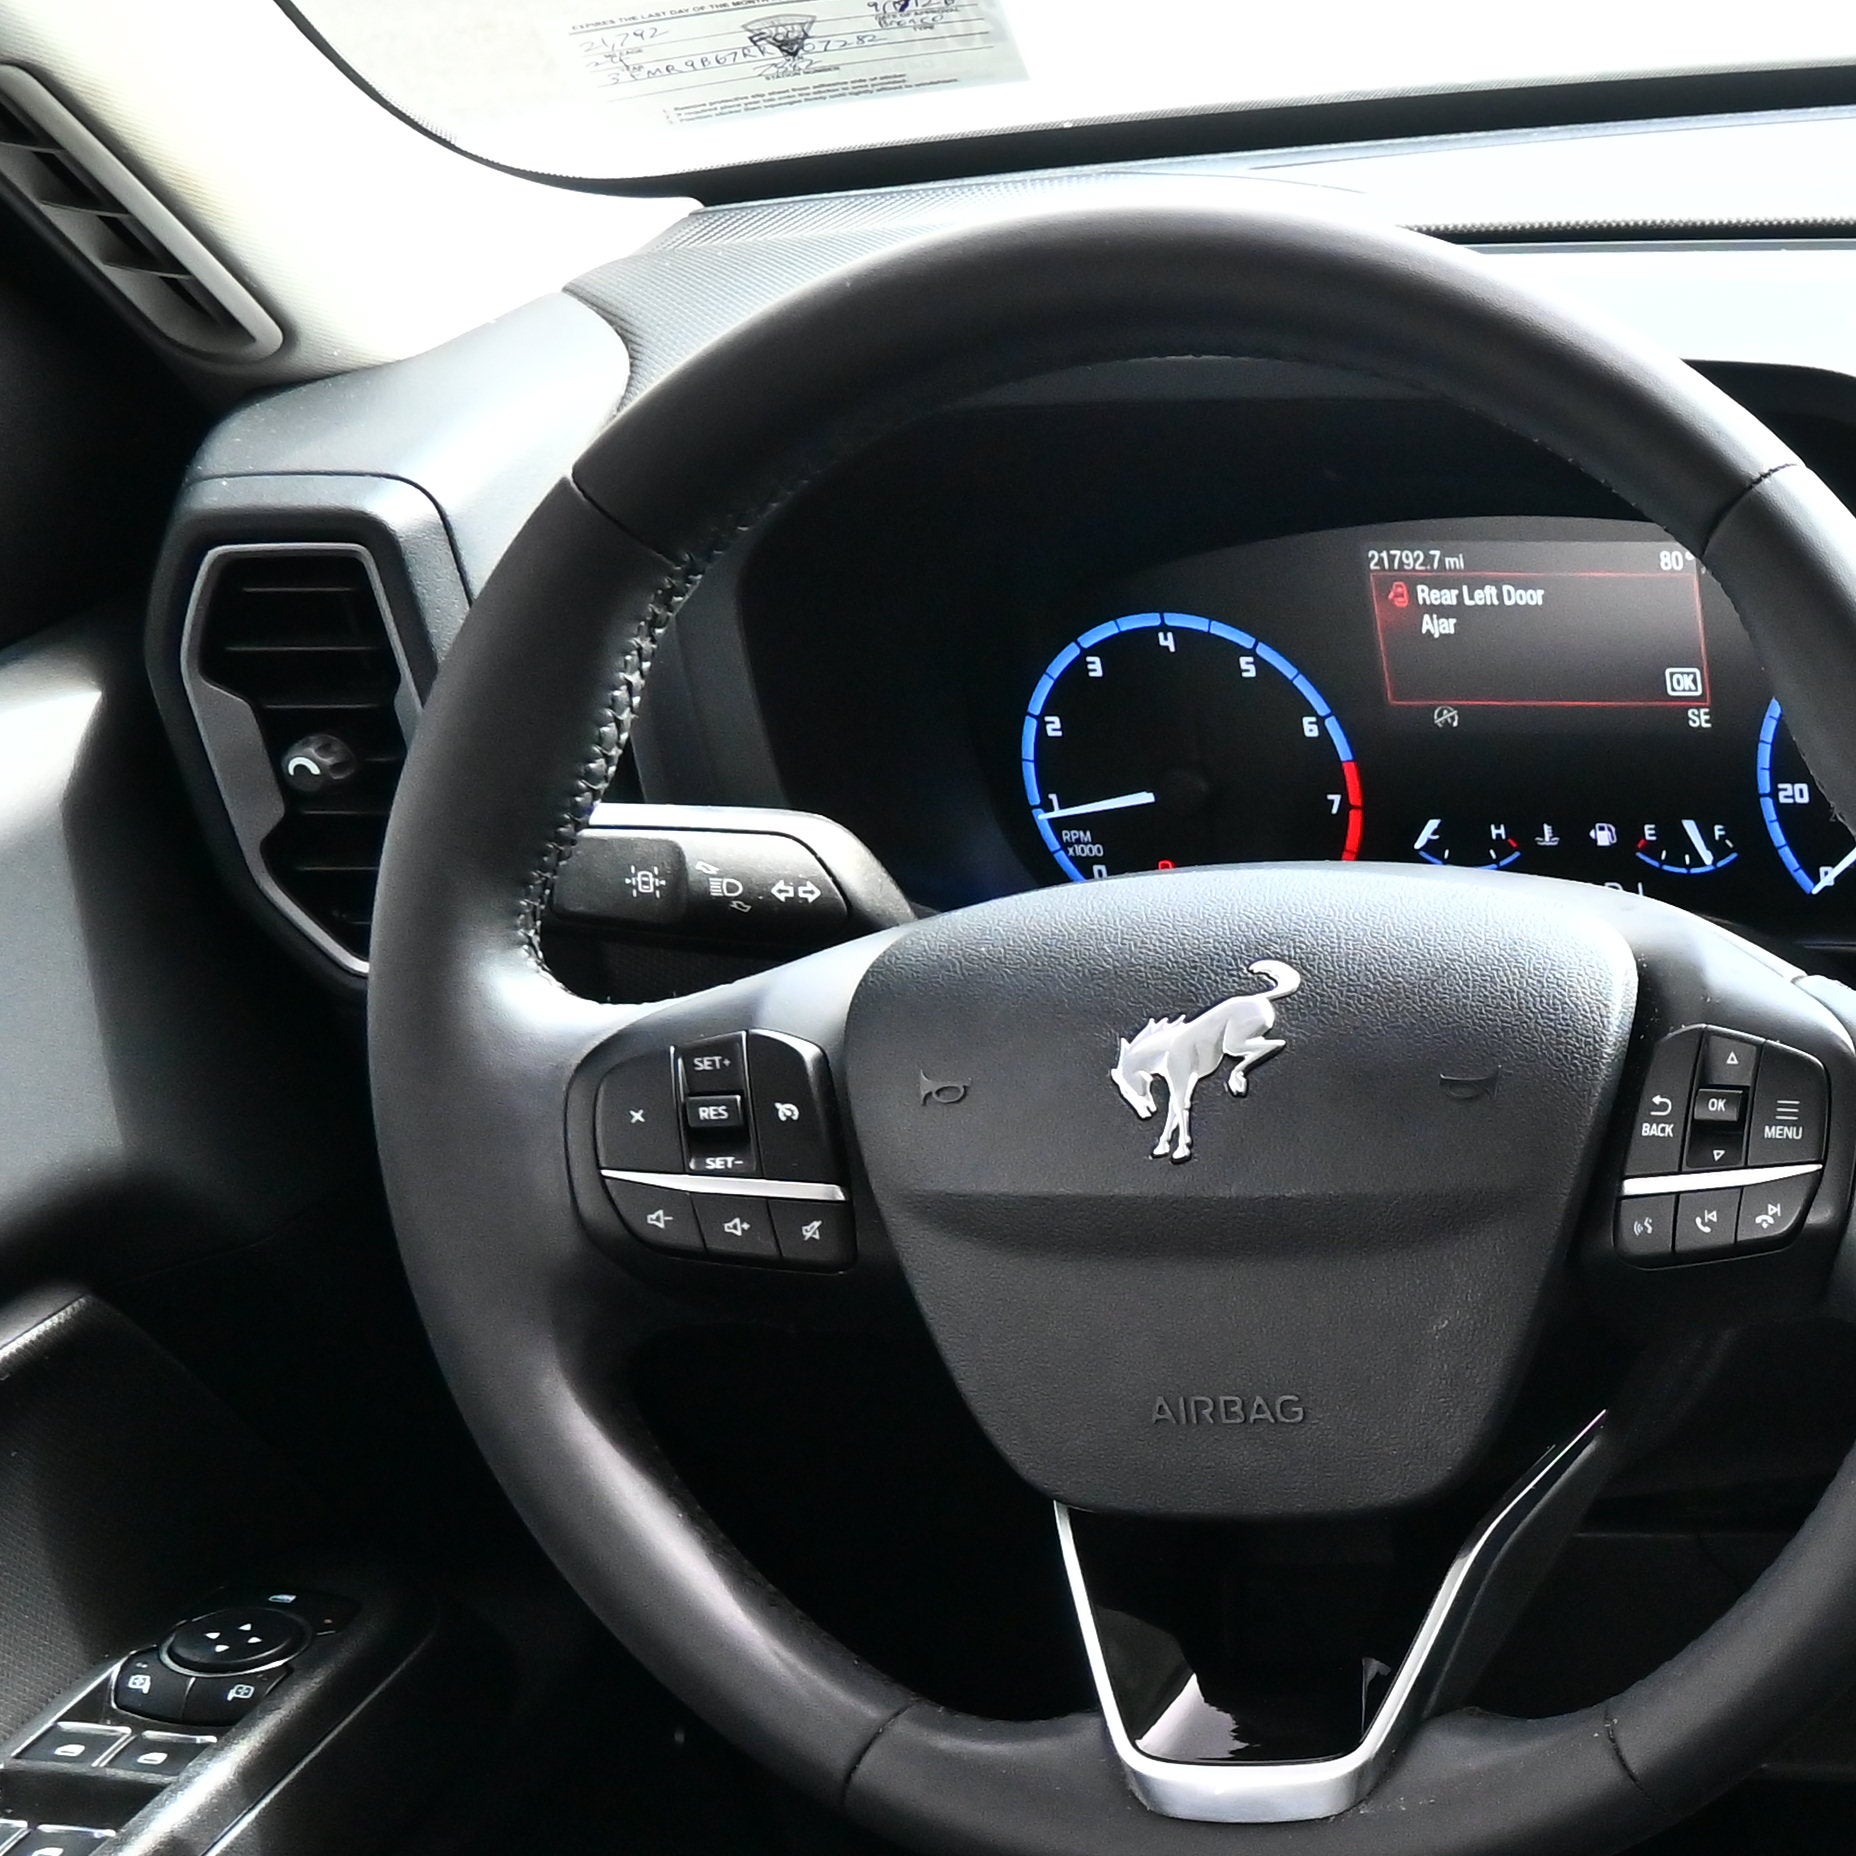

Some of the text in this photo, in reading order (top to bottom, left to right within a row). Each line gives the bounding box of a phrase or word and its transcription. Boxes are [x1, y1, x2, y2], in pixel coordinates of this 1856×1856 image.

[1368, 550, 1464, 571] 21792.7 mi
[1416, 584, 1545, 607] Rear Left Door
[1421, 613, 1457, 639] Ajar
[1158, 631, 1176, 653] 4
[1086, 655, 1104, 678] 3
[1239, 656, 1257, 678] 5
[1672, 673, 1697, 691] OK
[1044, 715, 1063, 737] 2
[1302, 716, 1320, 738] 6
[1687, 708, 1712, 728] SE
[1777, 782, 1810, 804] 20
[1326, 793, 1342, 815] 7
[1062, 830, 1092, 844] RPM
[1490, 824, 1506, 840] H
[1643, 824, 1657, 841] E
[1713, 825, 1726, 840] F
[1067, 844, 1104, 858] x1000
[693, 1056, 731, 1071] SET+
[699, 1105, 729, 1120] RES
[1707, 1098, 1727, 1112] OK
[1641, 1123, 1674, 1138] BACK
[1764, 1125, 1803, 1140] MENU
[1152, 1394, 1305, 1425] AIRBAG
